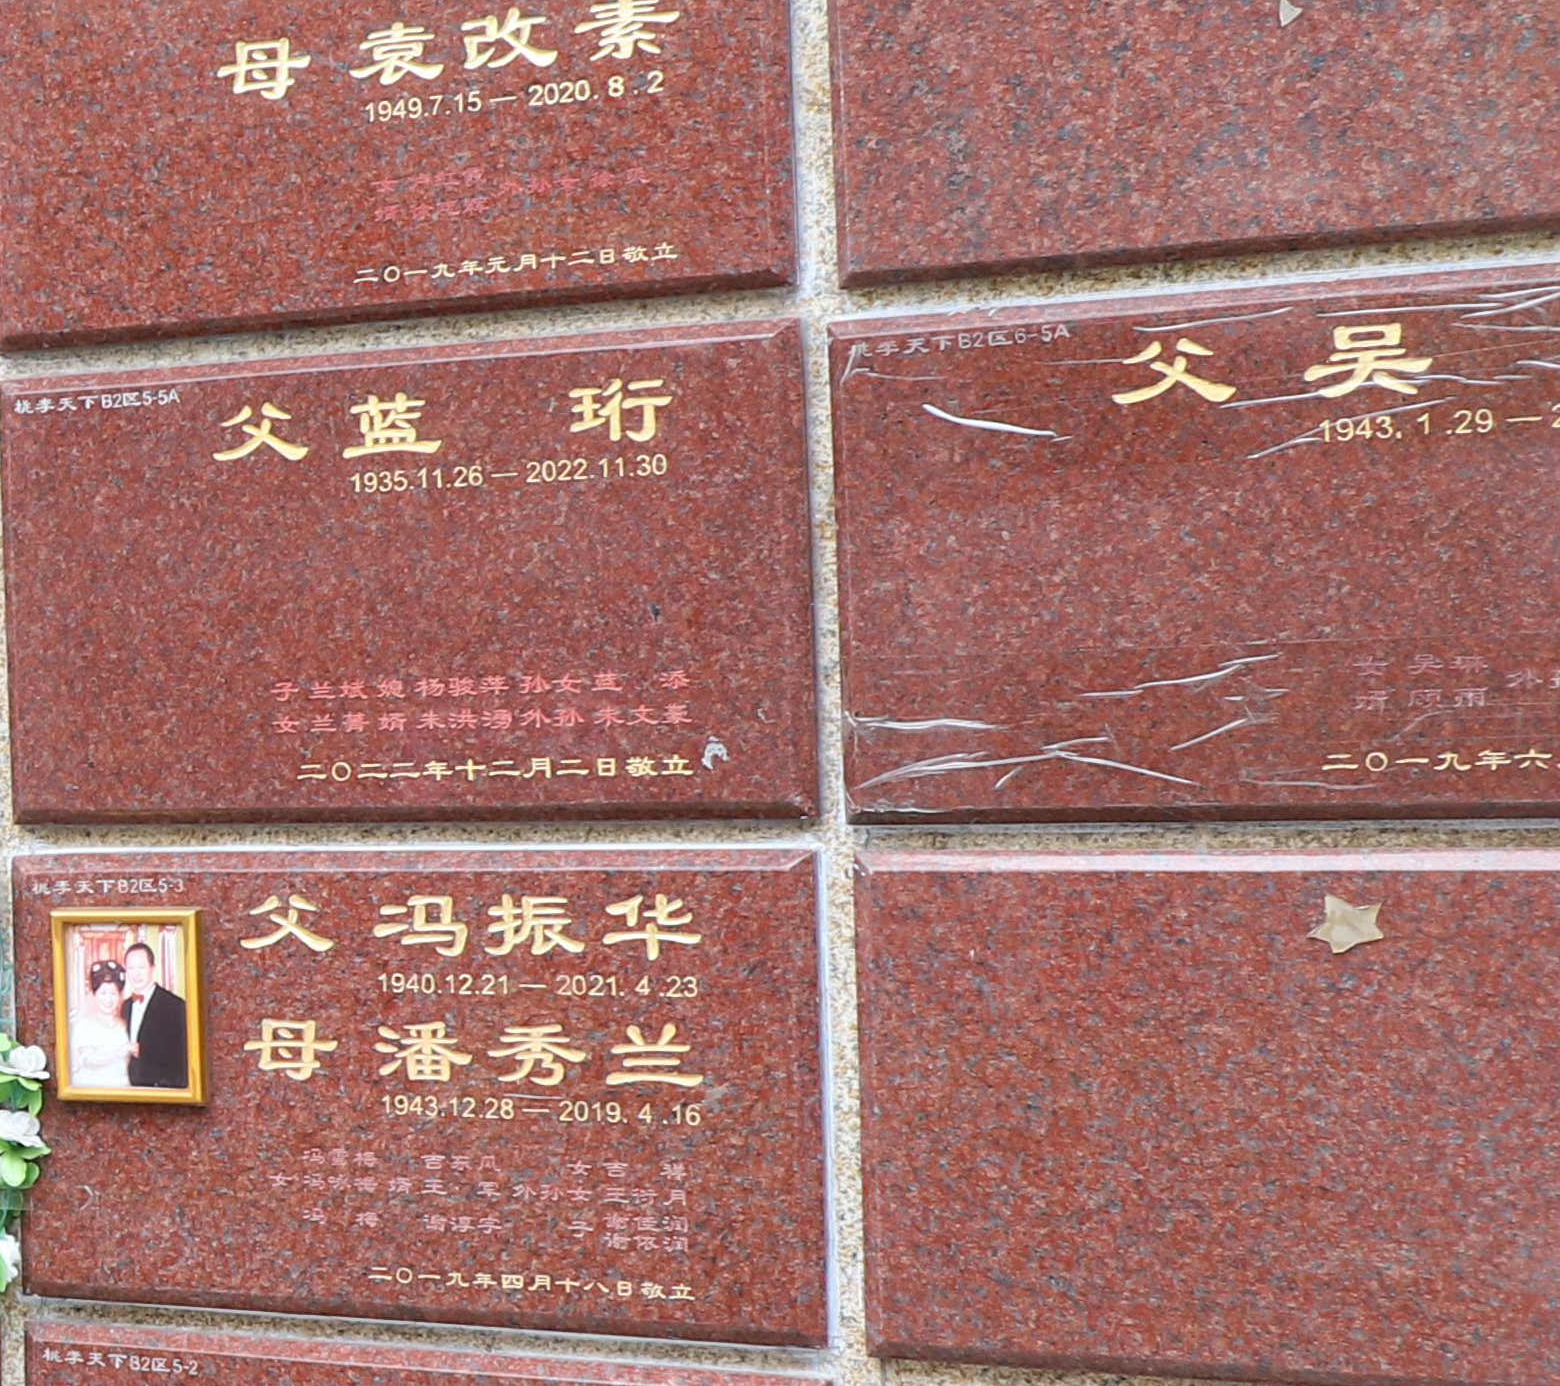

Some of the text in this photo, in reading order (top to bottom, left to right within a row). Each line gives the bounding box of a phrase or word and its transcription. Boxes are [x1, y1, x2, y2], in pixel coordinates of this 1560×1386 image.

[1323, 747, 1560, 774] 二〇一九年六
